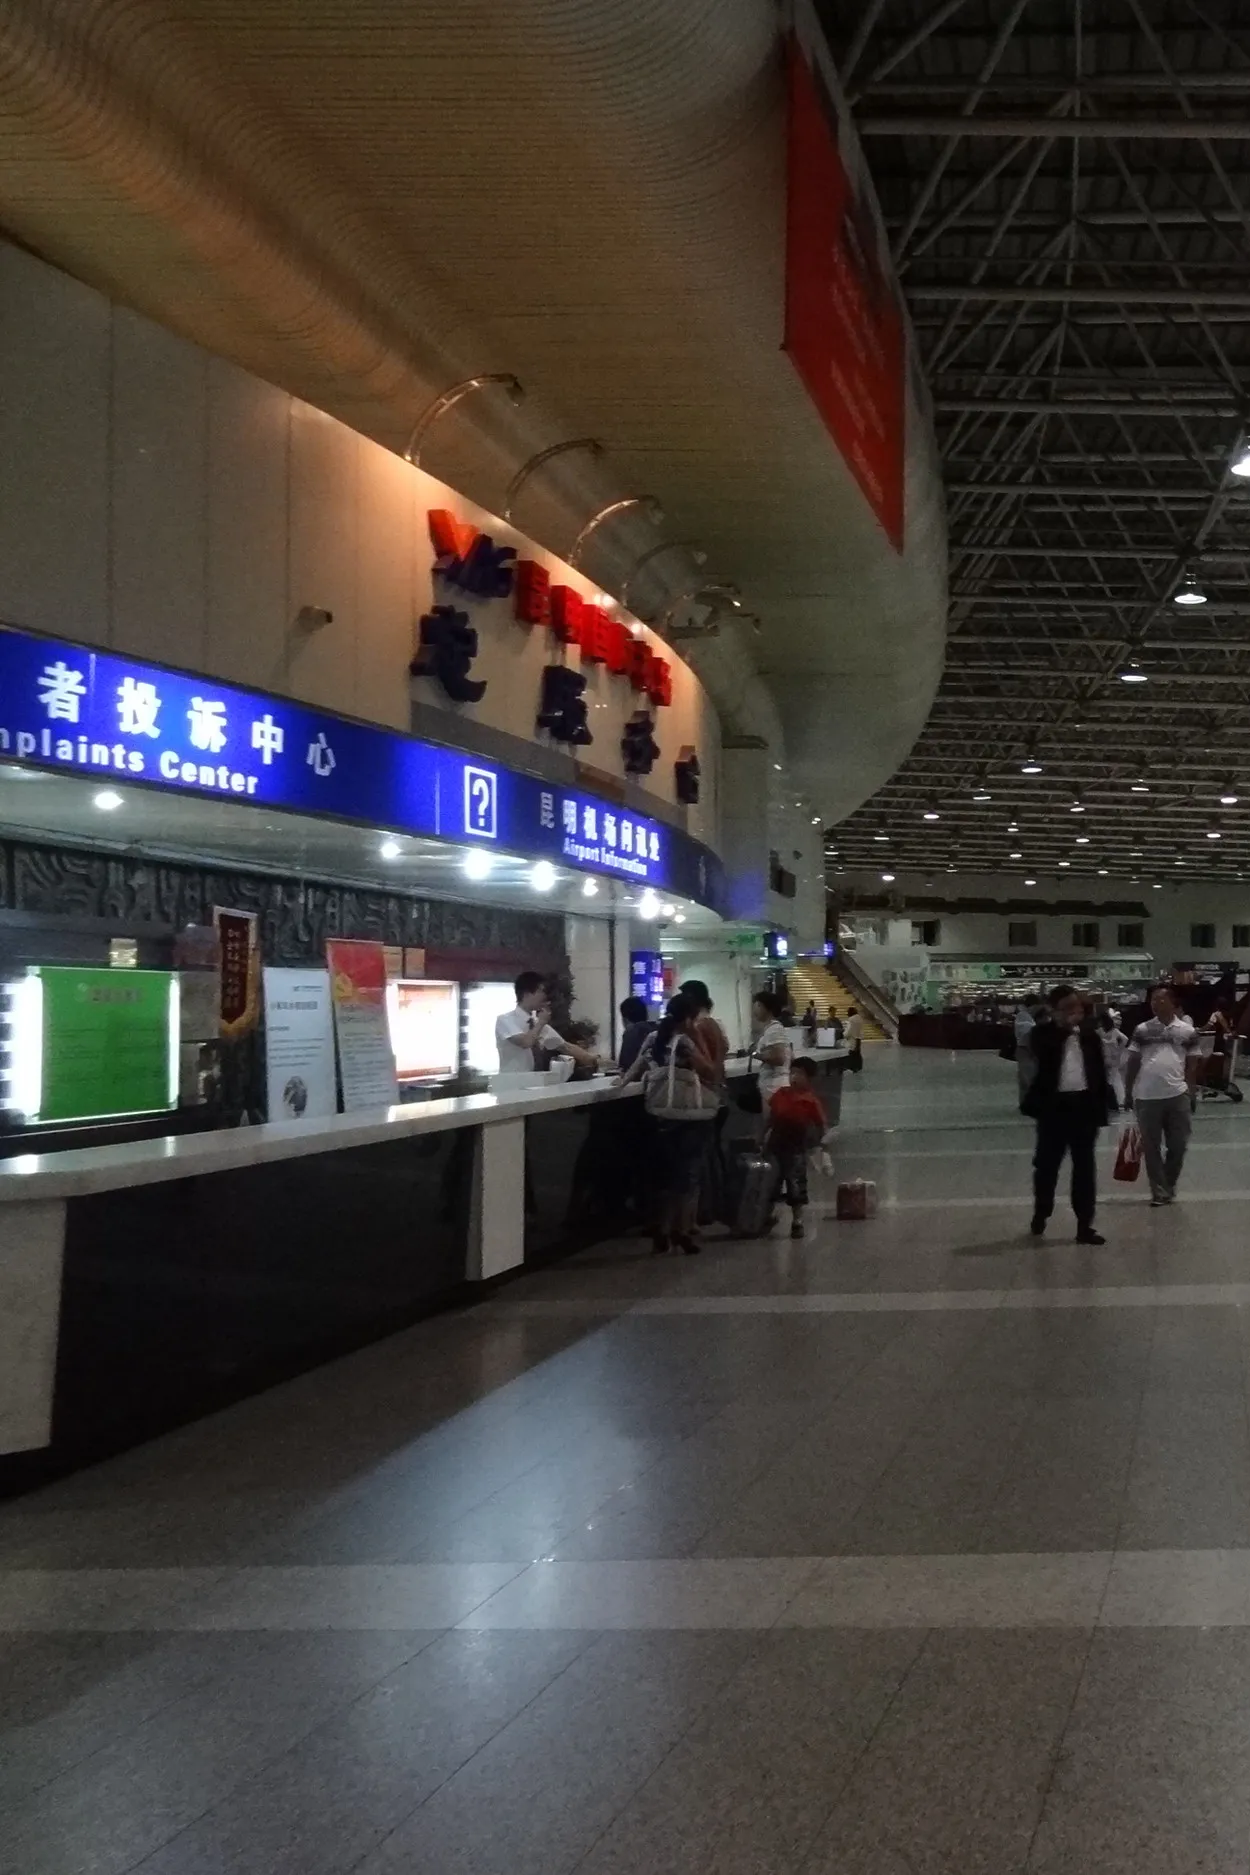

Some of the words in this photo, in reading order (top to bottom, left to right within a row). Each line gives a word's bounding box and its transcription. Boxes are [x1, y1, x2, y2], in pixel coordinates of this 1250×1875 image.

[37, 661, 336, 776] 者投诉中心
[159, 750, 259, 794] Center
